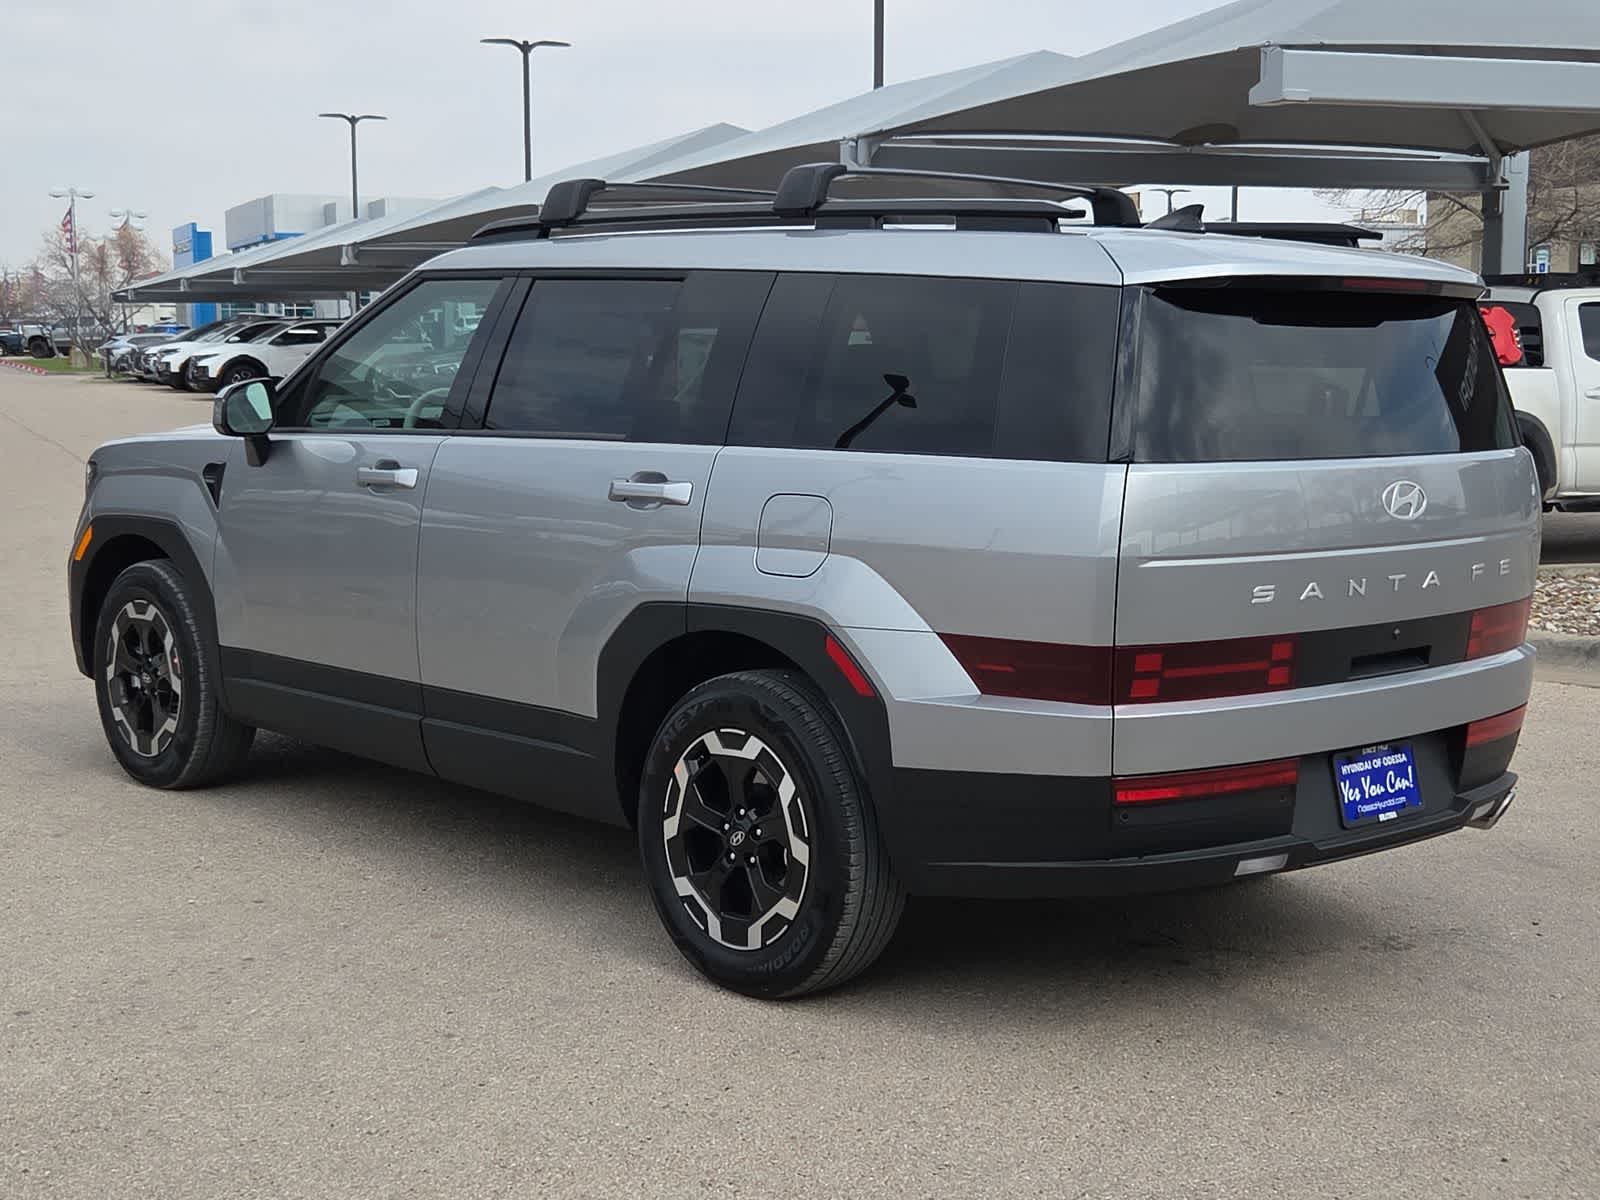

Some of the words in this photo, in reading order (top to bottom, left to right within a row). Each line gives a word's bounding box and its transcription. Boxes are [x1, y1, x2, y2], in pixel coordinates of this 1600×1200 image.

[1251, 569, 1441, 605] SANTA
[1471, 558, 1512, 582] FE
[1342, 761, 1372, 775] HYUNDAI
[1373, 759, 1381, 769] OF
[1383, 754, 1407, 766] ODESSA
[1340, 779, 1361, 804] Yes
[1361, 775, 1385, 799] You
[1386, 765, 1414, 793] Can!
